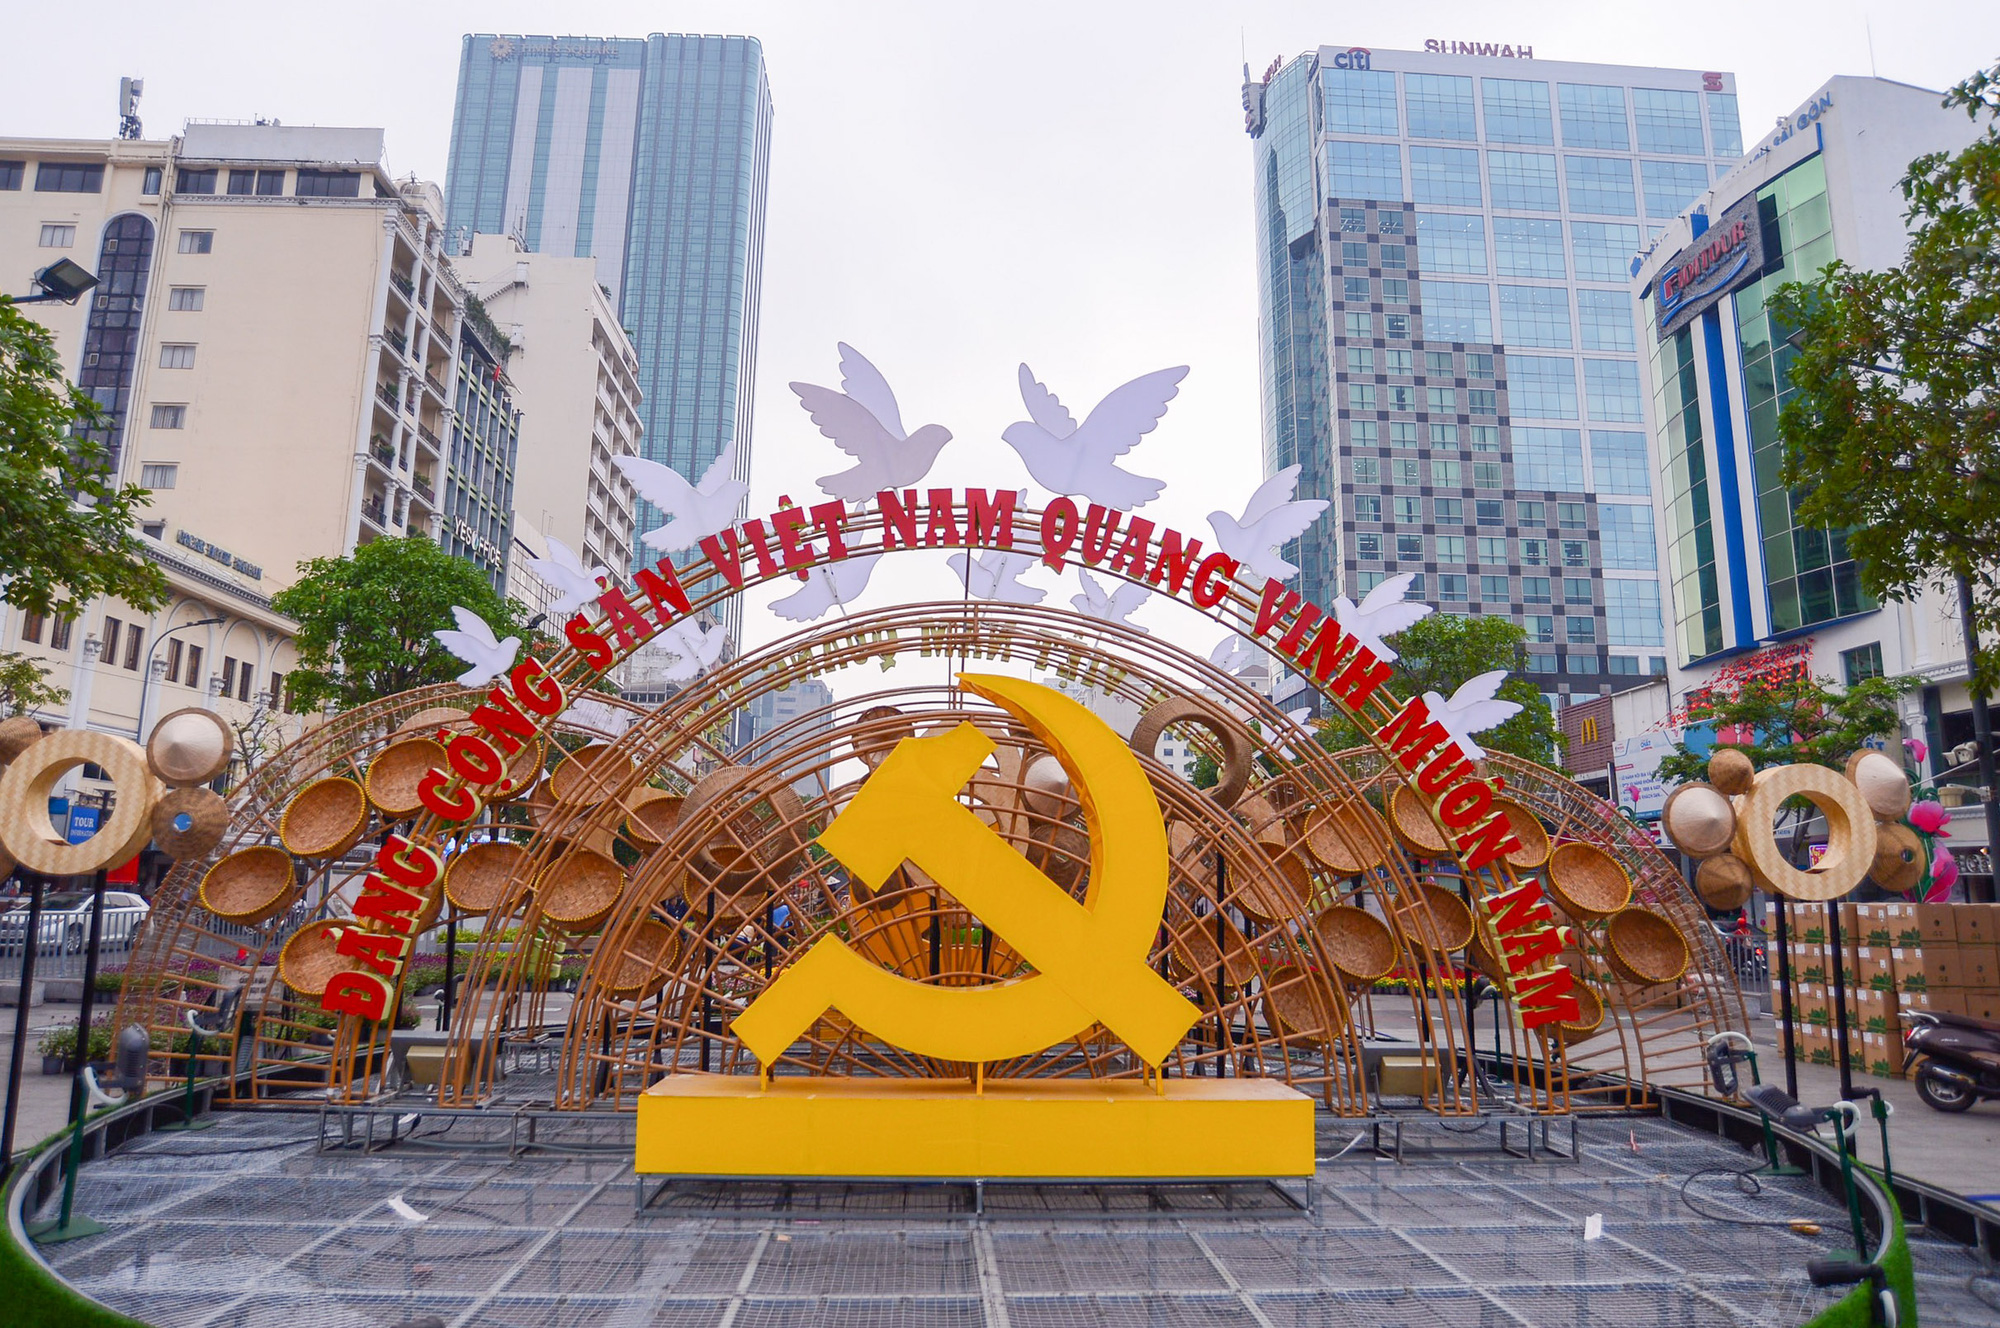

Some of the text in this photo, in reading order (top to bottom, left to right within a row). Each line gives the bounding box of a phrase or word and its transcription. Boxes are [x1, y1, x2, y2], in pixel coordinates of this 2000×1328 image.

[521, 43, 619, 57] TIMES SQUARE
[1334, 47, 1371, 70] citi
[1424, 39, 1533, 59] SUNWAH
[1664, 220, 1746, 301] FIDITOUR
[321, 833, 445, 1021] ĐẢNG
[417, 656, 567, 822] CỘNG
[565, 556, 695, 672] SẢN
[699, 494, 849, 590] VIỆT
[877, 488, 1017, 549] NAM
[1040, 496, 1241, 610] QUANG
[1250, 577, 1393, 711] VINH
[1373, 696, 1522, 872] MUÔN
[1480, 877, 1581, 1029] NĂM
[74, 817, 94, 828] TOUR
